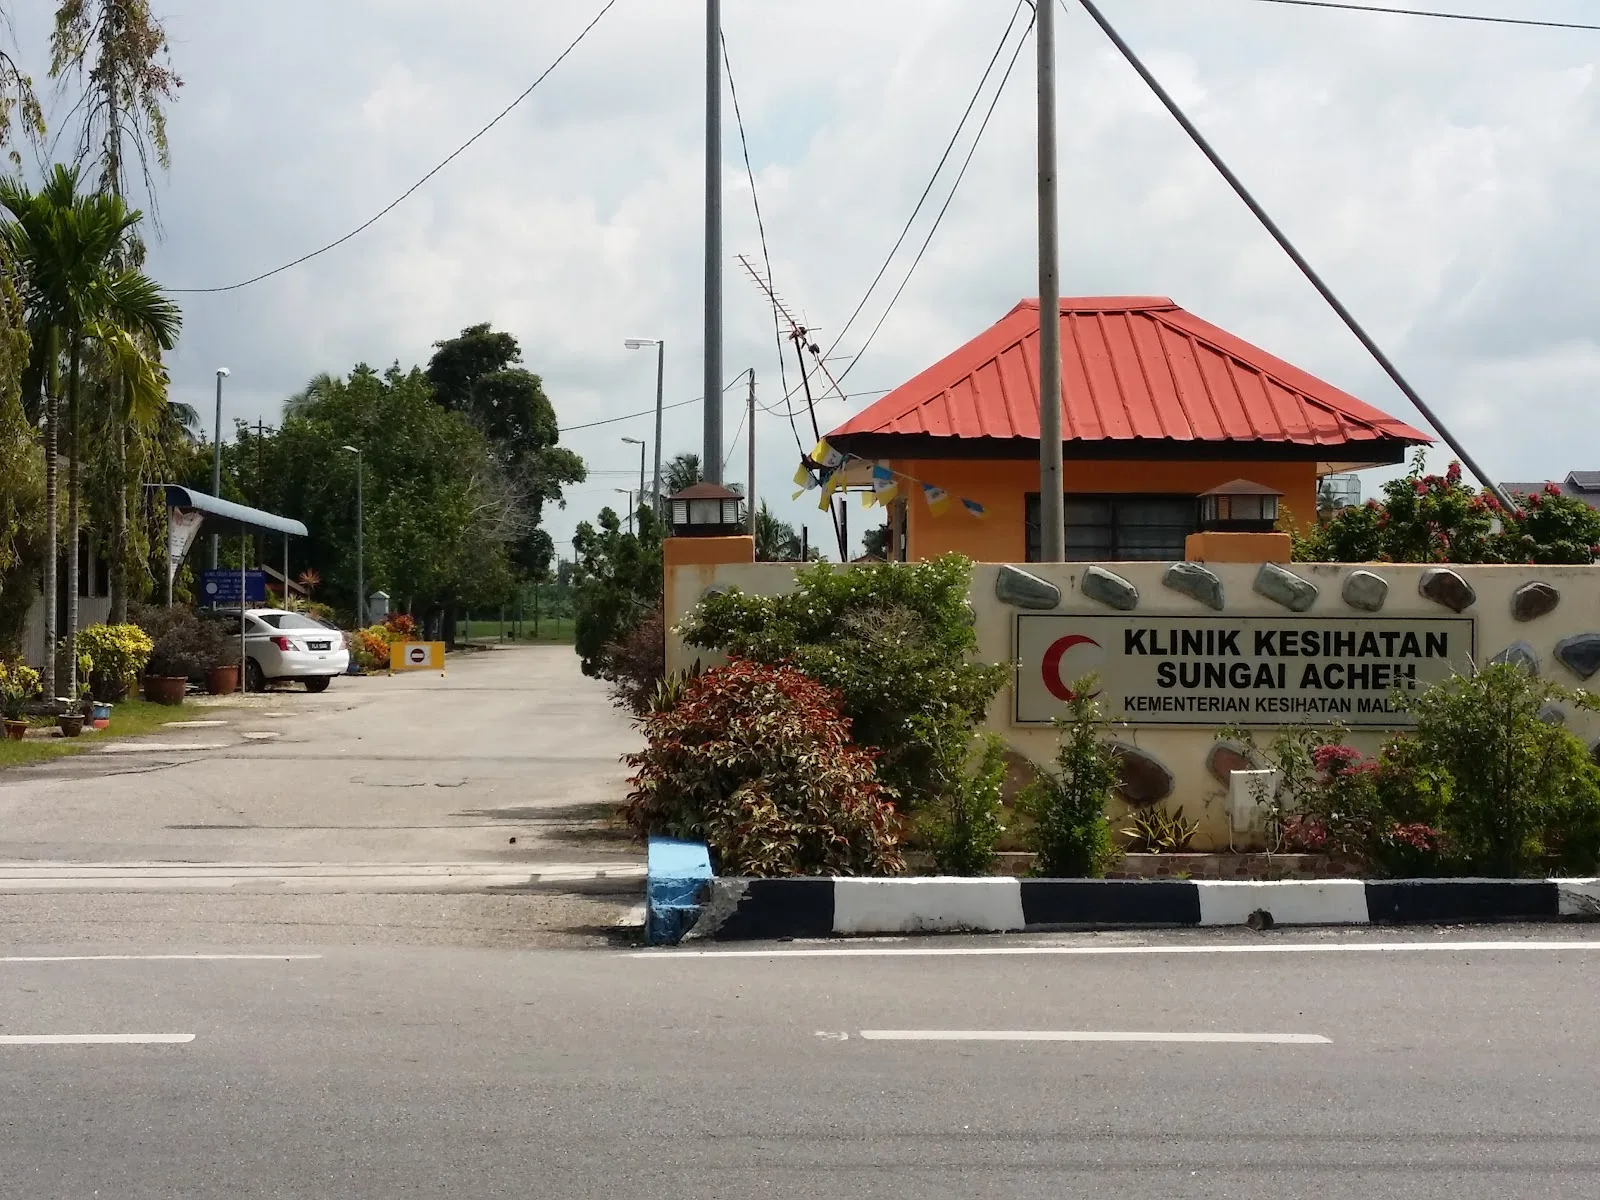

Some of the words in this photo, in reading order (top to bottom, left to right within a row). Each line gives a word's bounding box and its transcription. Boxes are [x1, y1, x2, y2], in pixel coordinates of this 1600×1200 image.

[1124, 629, 1241, 656] KLINIK
[1254, 630, 1448, 657] KESIHATAN
[1156, 662, 1286, 689] SUNGAI
[1300, 663, 1416, 690] ACHEH
[1124, 696, 1250, 712] KEMENTERIAN
[1255, 697, 1351, 713] KESIHATAN
